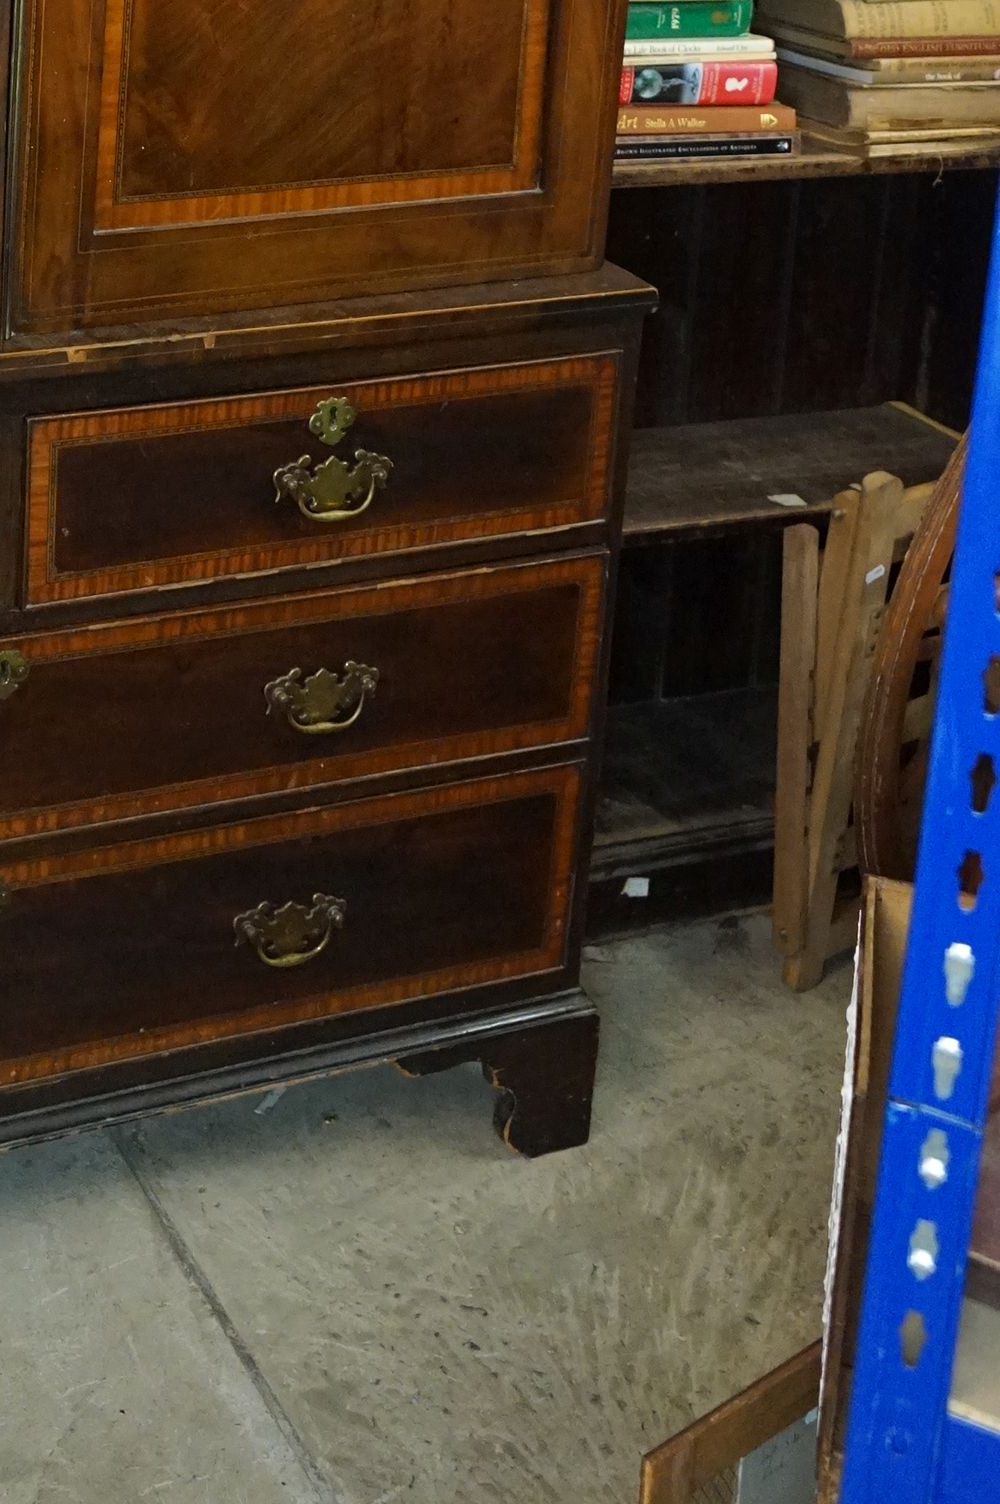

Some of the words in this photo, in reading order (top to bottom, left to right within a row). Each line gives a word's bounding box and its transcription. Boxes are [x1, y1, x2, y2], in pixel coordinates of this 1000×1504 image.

[649, 45, 666, 53] Book
[617, 115, 638, 129] Art
[667, 118, 675, 128] A
